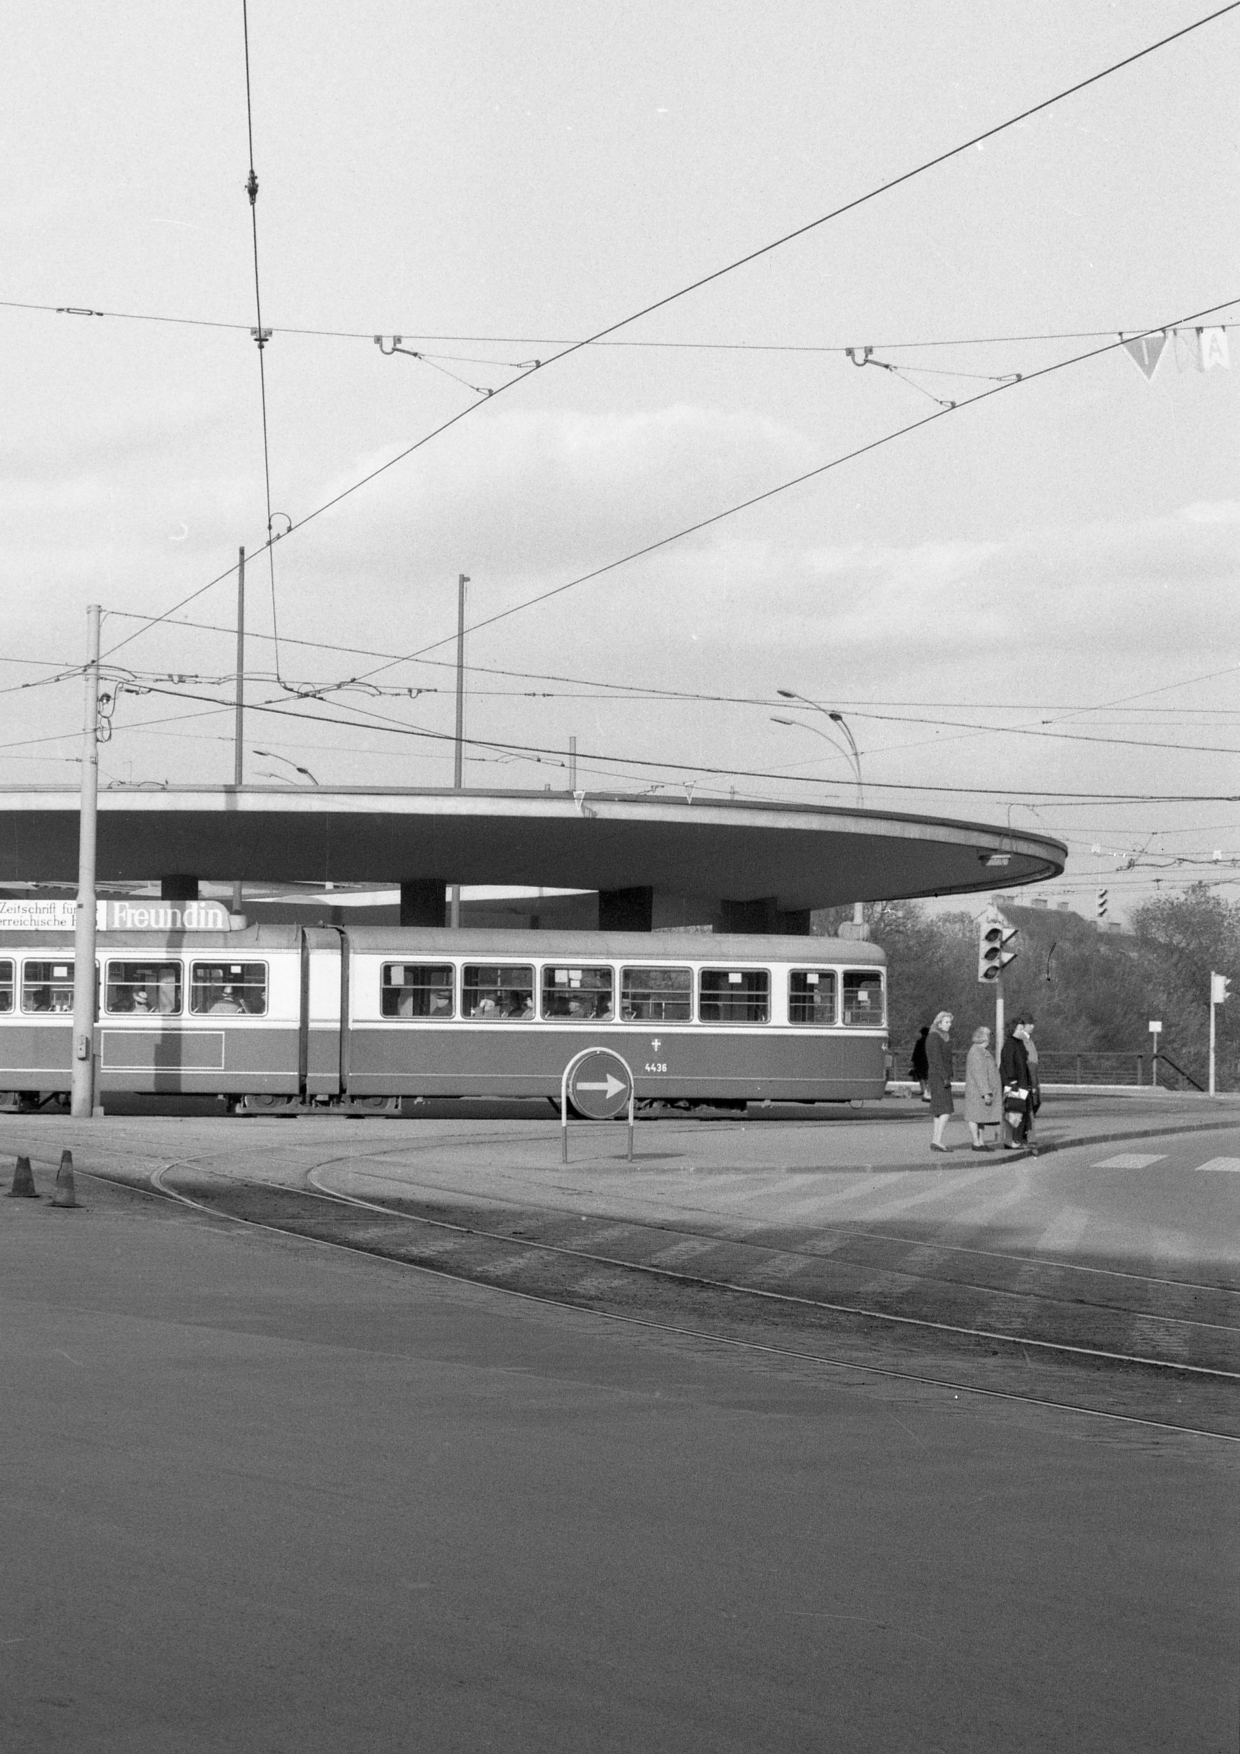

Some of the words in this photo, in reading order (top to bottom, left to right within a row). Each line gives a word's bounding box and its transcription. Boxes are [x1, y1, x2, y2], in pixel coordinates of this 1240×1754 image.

[0, 901, 56, 914] Zeitschrift
[112, 901, 224, 929] Freundin
[645, 1063, 667, 1072] 4436
